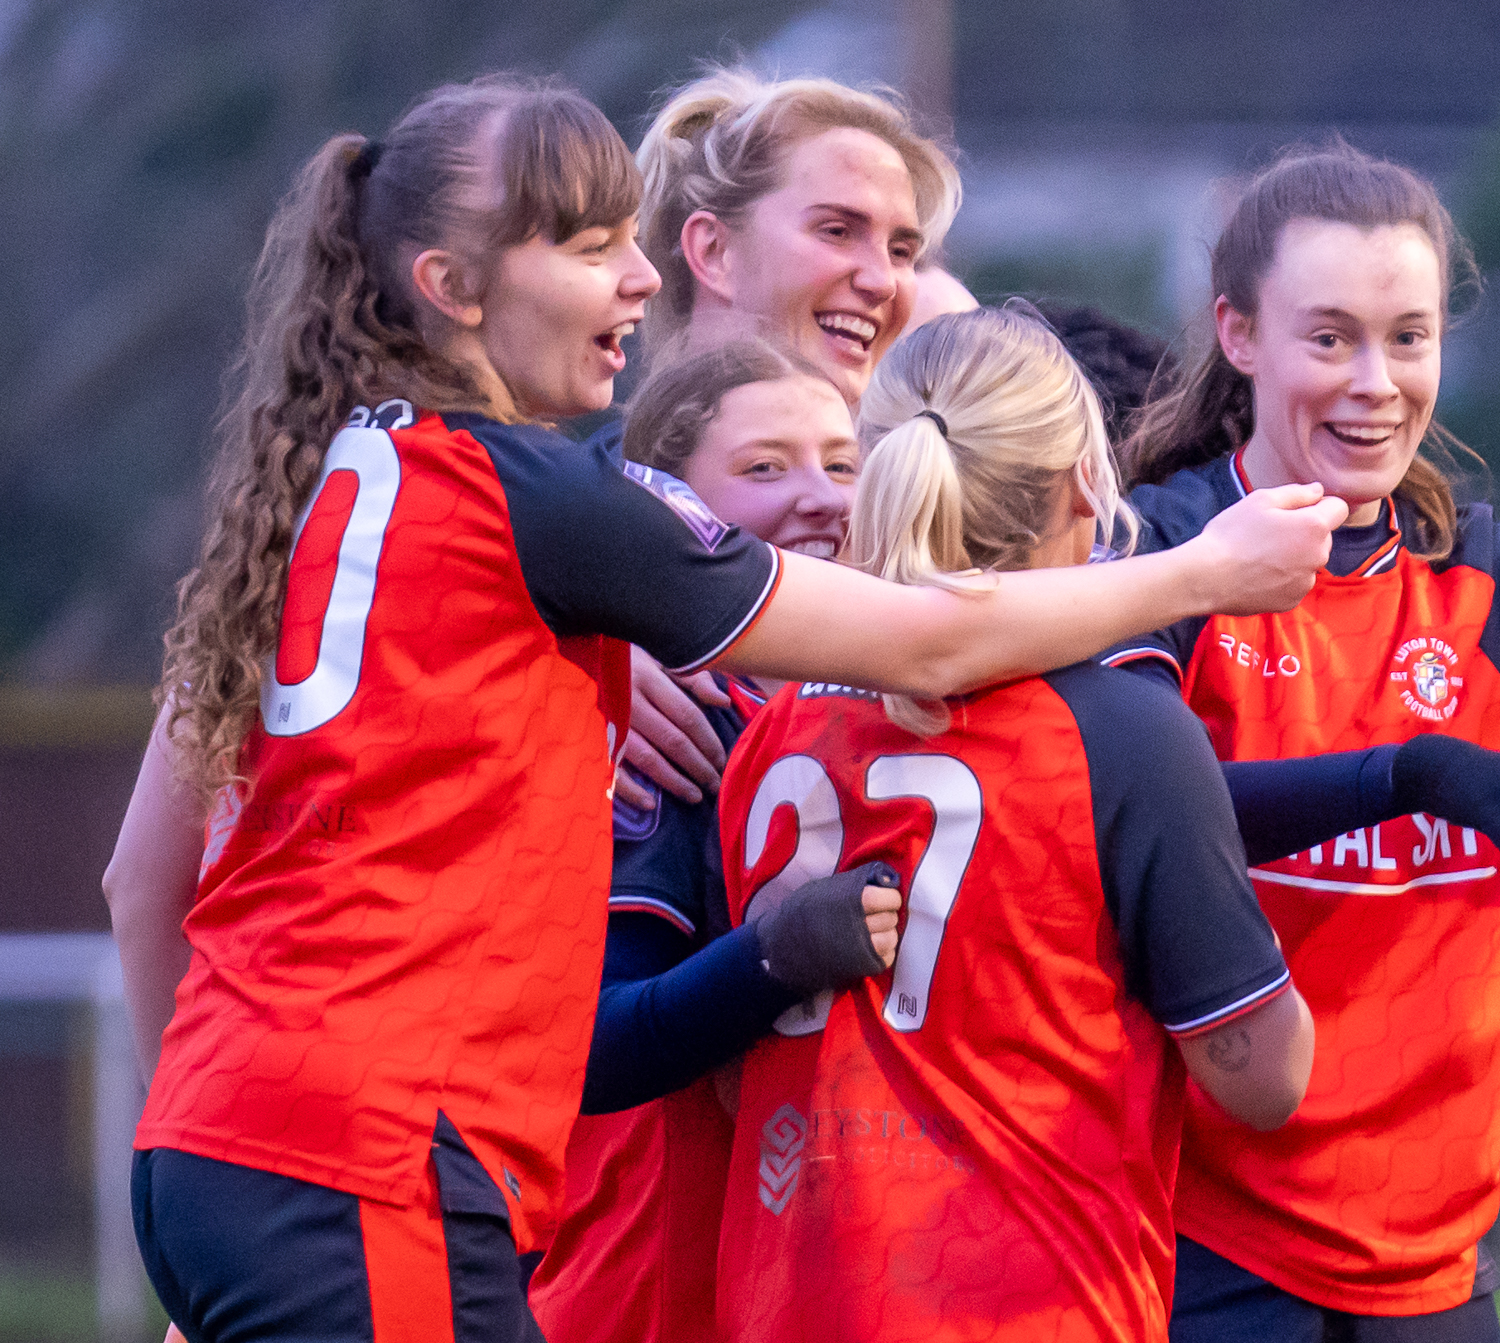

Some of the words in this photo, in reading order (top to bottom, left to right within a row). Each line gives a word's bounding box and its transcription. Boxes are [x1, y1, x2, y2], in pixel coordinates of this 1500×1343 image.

[1218, 633, 1301, 677] REFLO
[1394, 638, 1427, 664] LUTON
[1430, 638, 1459, 666] TOWN
[743, 753, 982, 1036] 27
